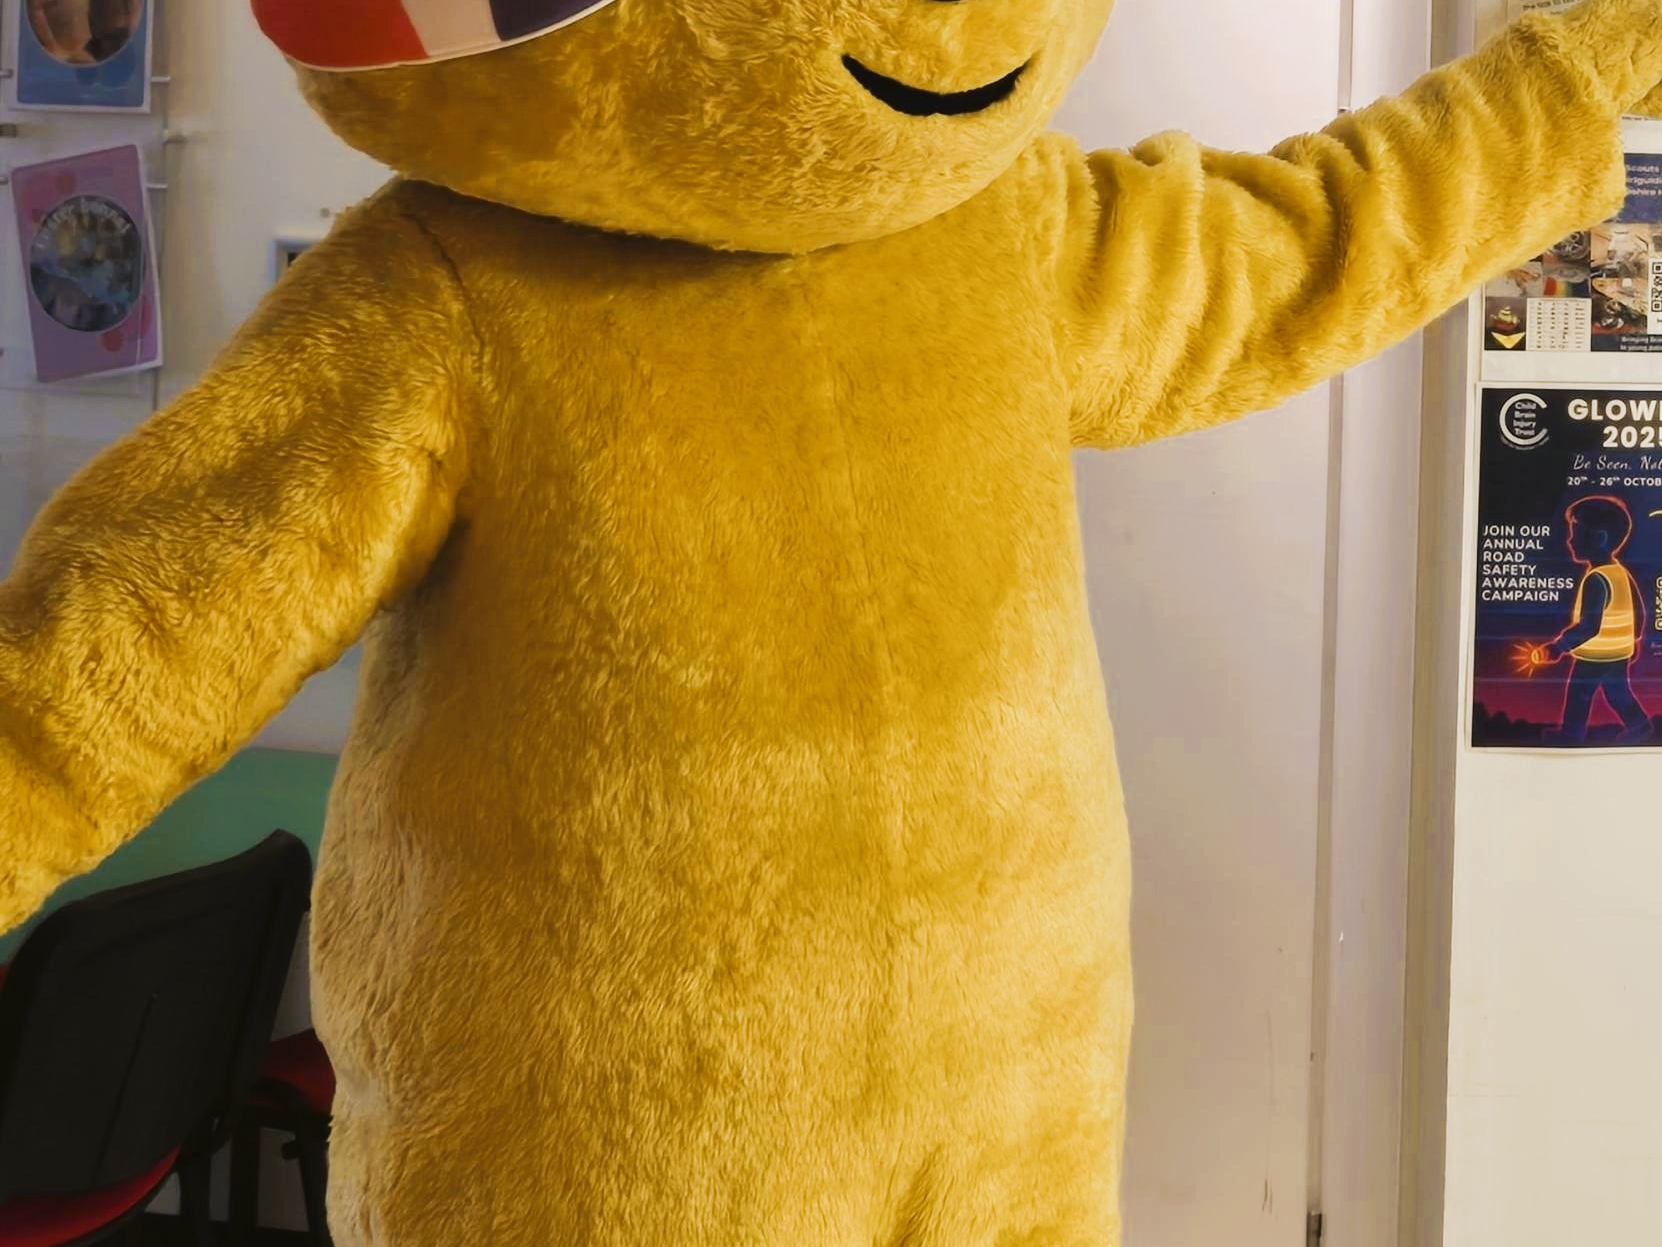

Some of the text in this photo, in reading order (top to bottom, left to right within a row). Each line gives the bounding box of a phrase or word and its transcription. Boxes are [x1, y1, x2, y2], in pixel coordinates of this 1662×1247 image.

[1573, 454, 1591, 470] Be
[1483, 524, 1550, 537] JOIN OUR
[1482, 538, 1544, 550] ANNUAL
[1482, 550, 1525, 563] ROAD
[1482, 564, 1537, 576] SAFETY
[1481, 576, 1574, 589] AWARENESS
[1481, 589, 1559, 602] CAMPAIGN
